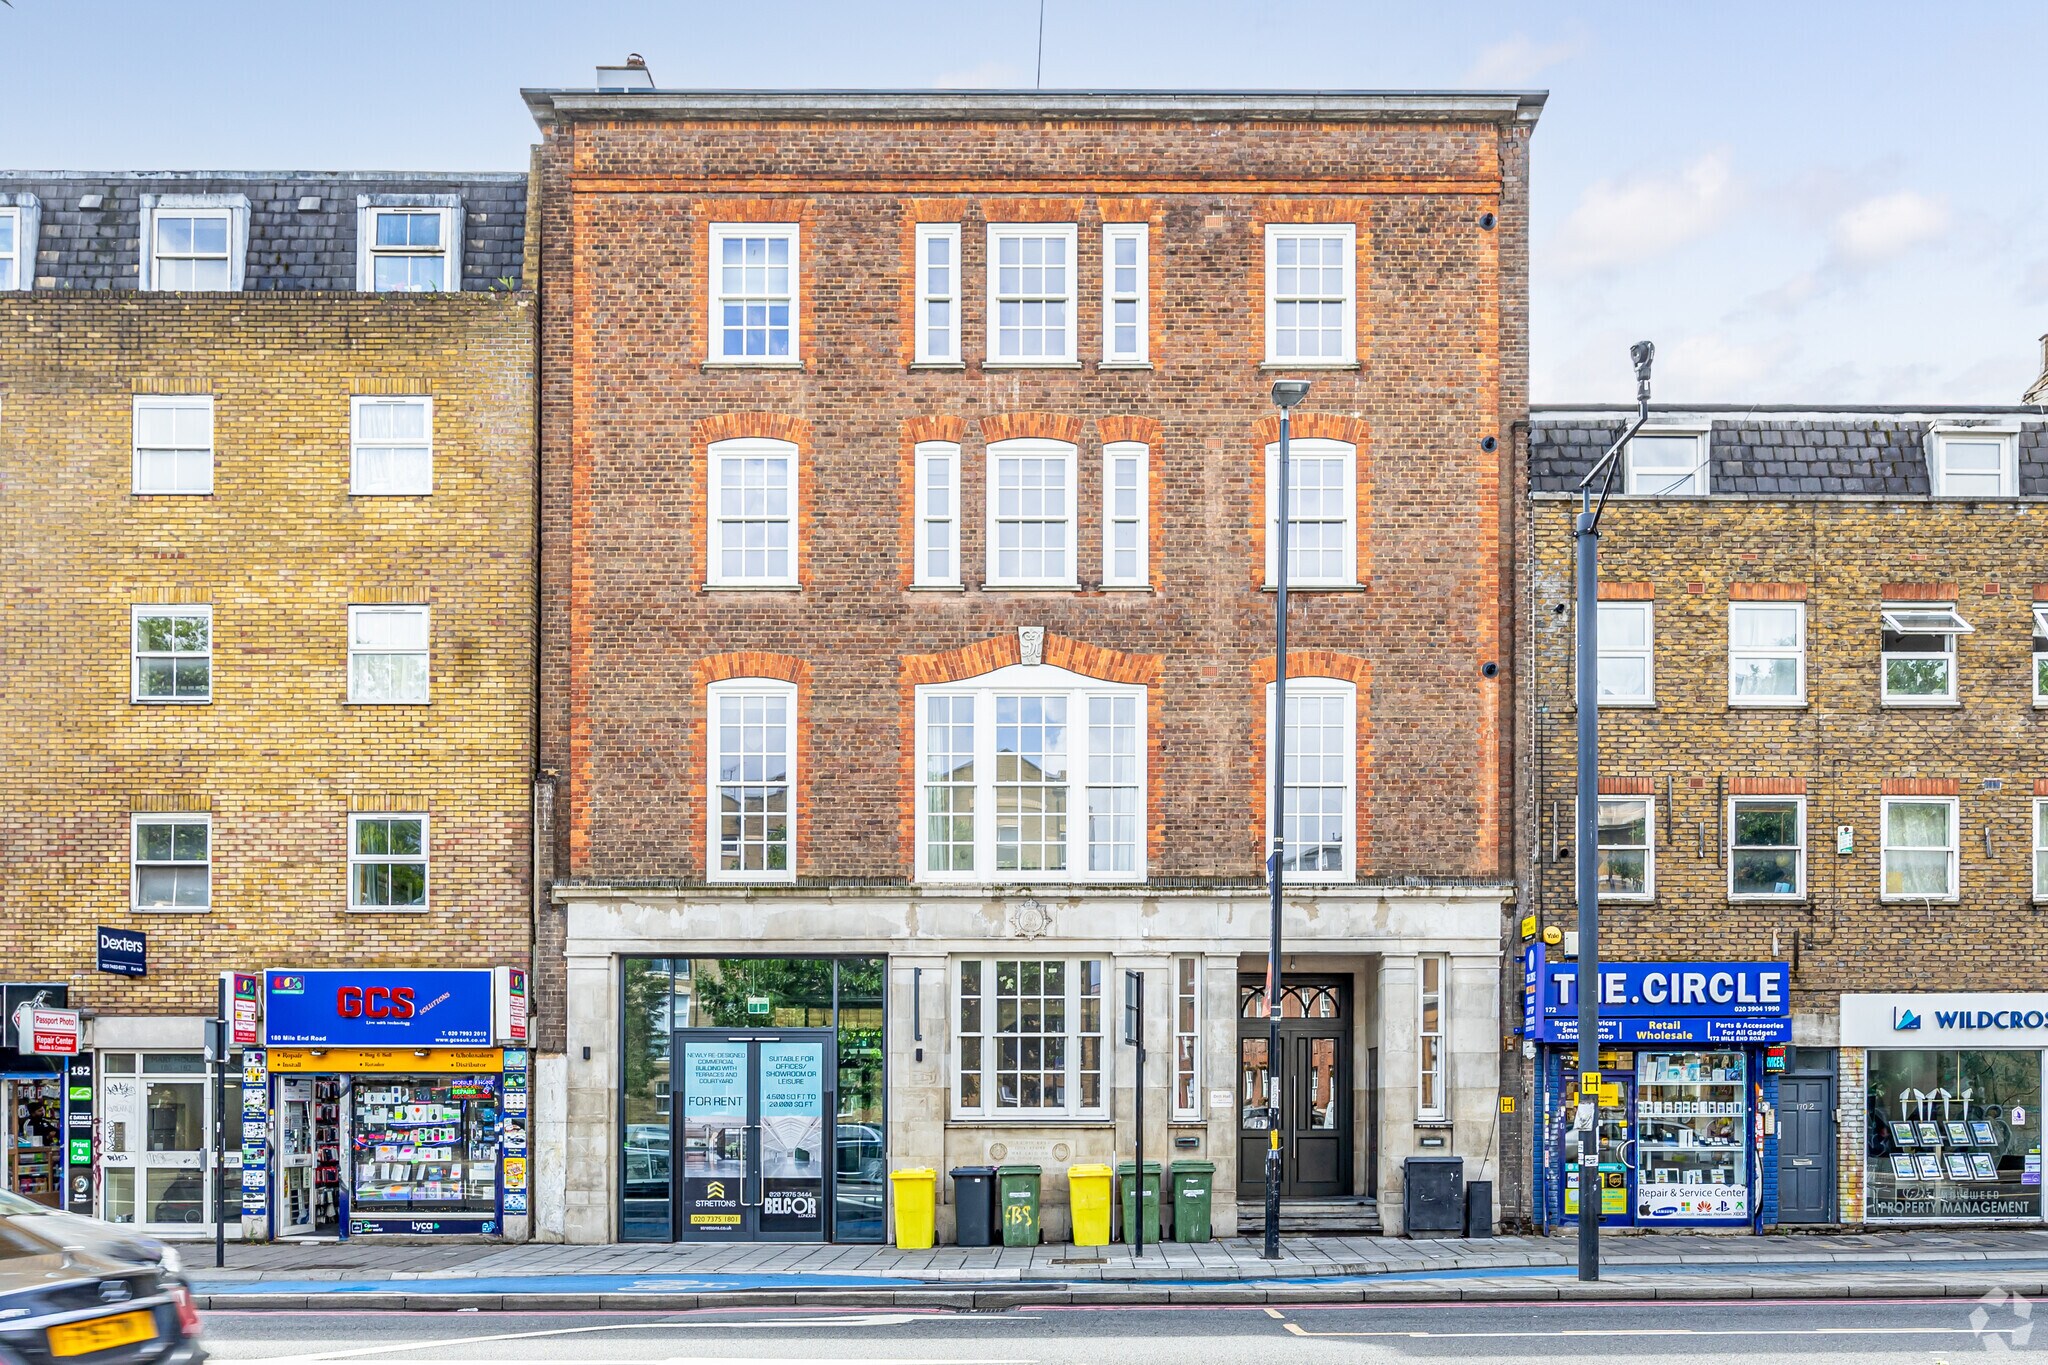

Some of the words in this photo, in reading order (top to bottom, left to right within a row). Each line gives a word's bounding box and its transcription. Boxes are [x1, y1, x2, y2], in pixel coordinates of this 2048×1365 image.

[101, 934, 143, 953] Dexters
[1553, 972, 1781, 1004] TE.CIRCLE
[337, 986, 415, 1018] GCS
[419, 991, 450, 1016] SOLUTIONS
[36, 1016, 58, 1026] Passport
[60, 1018, 74, 1026] Photo
[1554, 1020, 1578, 1028] Repair
[1649, 1021, 1680, 1030] Retail
[1636, 1031, 1693, 1040] Wholesale
[1747, 1030, 1777, 1038] Gadgets
[36, 1036, 54, 1045] Repair
[55, 1036, 74, 1045] Center
[71, 1066, 90, 1076] 182
[689, 1097, 711, 1106] FOR
[714, 1097, 743, 1106] RENT
[72, 1154, 88, 1162] Copy
[1639, 1188, 1668, 1199] Repair
[1670, 1188, 1677, 1197] &
[1679, 1188, 1712, 1197] Service
[1715, 1188, 1745, 1197] Center
[764, 1198, 816, 1214] BELCOR
[1880, 1202, 1937, 1214] PROPERTY
[1942, 1202, 2029, 1214] MANAGEMENT
[412, 1221, 433, 1231] Lyca
